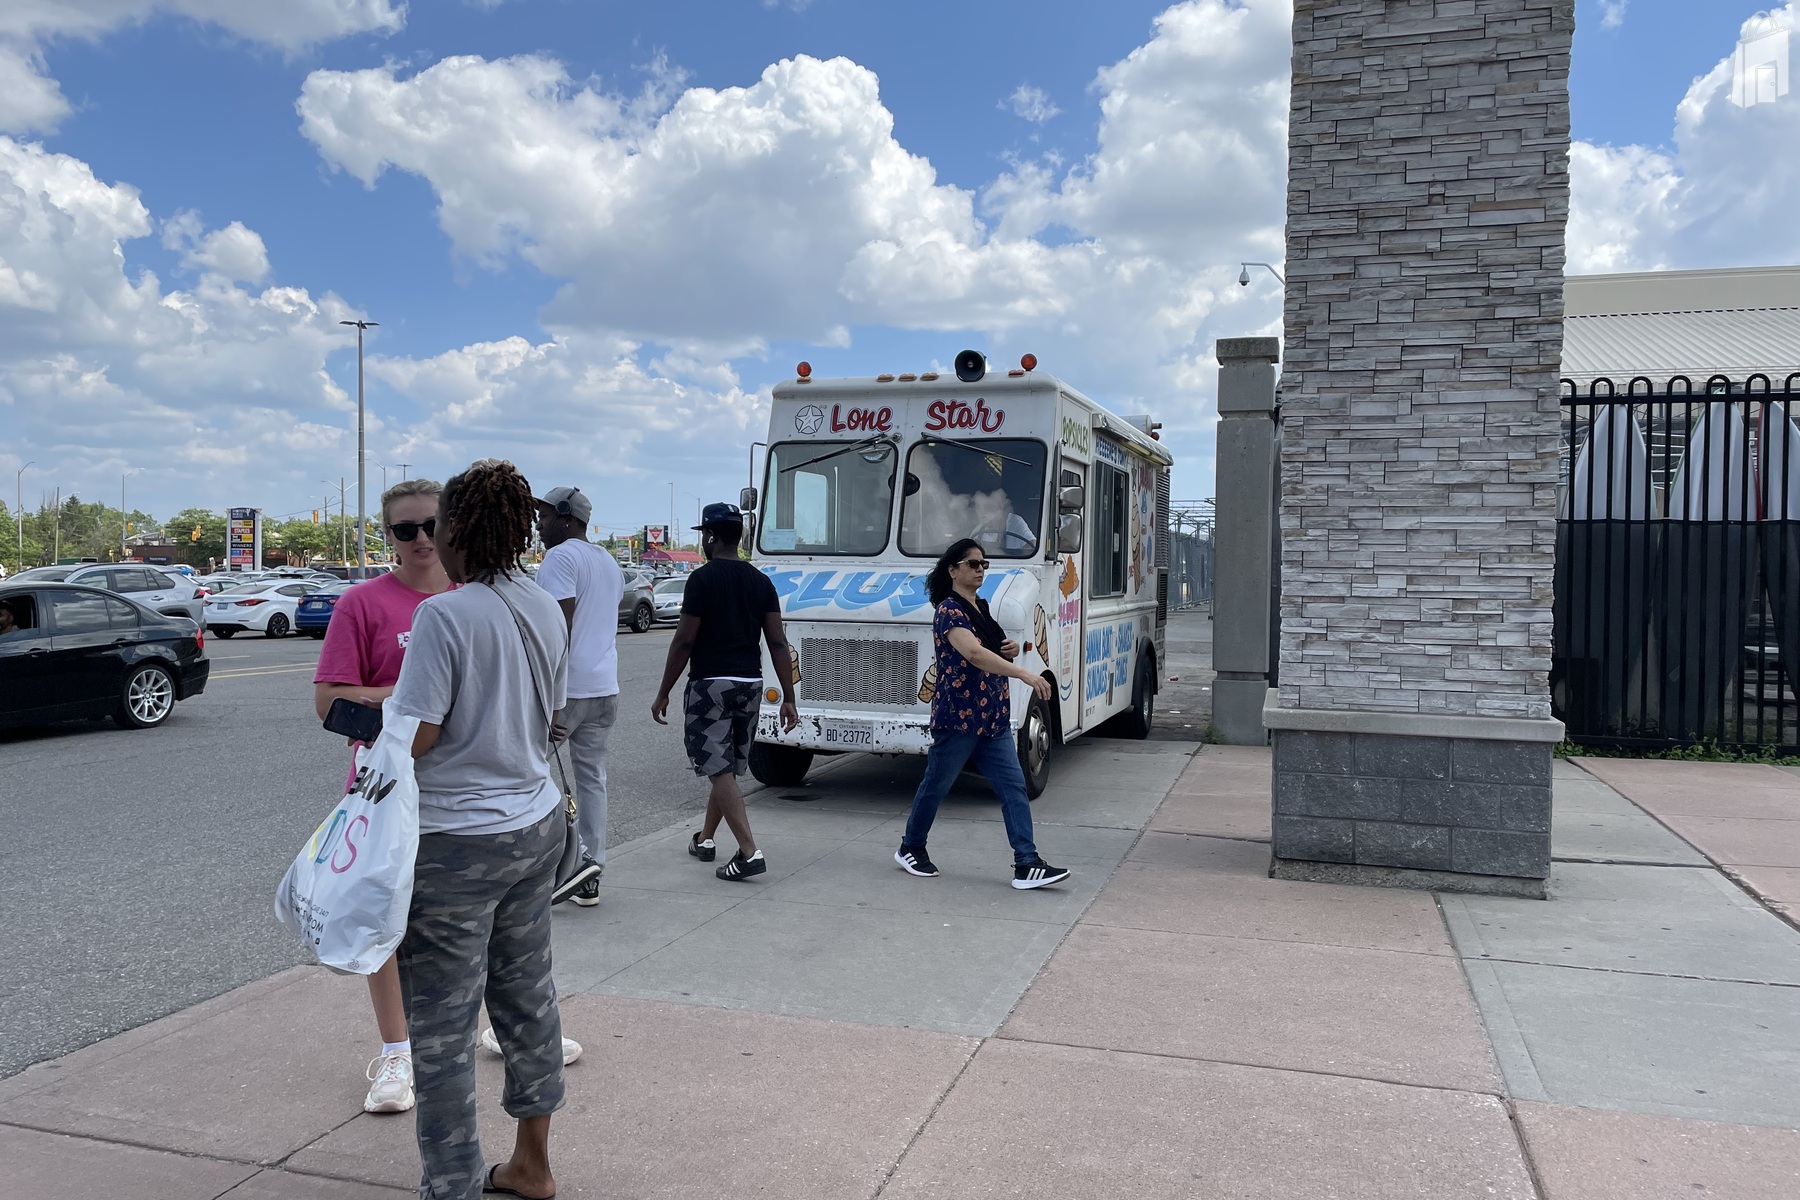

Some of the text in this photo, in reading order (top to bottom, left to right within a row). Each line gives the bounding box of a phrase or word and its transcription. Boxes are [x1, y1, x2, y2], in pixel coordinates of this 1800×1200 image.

[831, 398, 1004, 433] Lone Star
[843, 730, 871, 744] 23772
